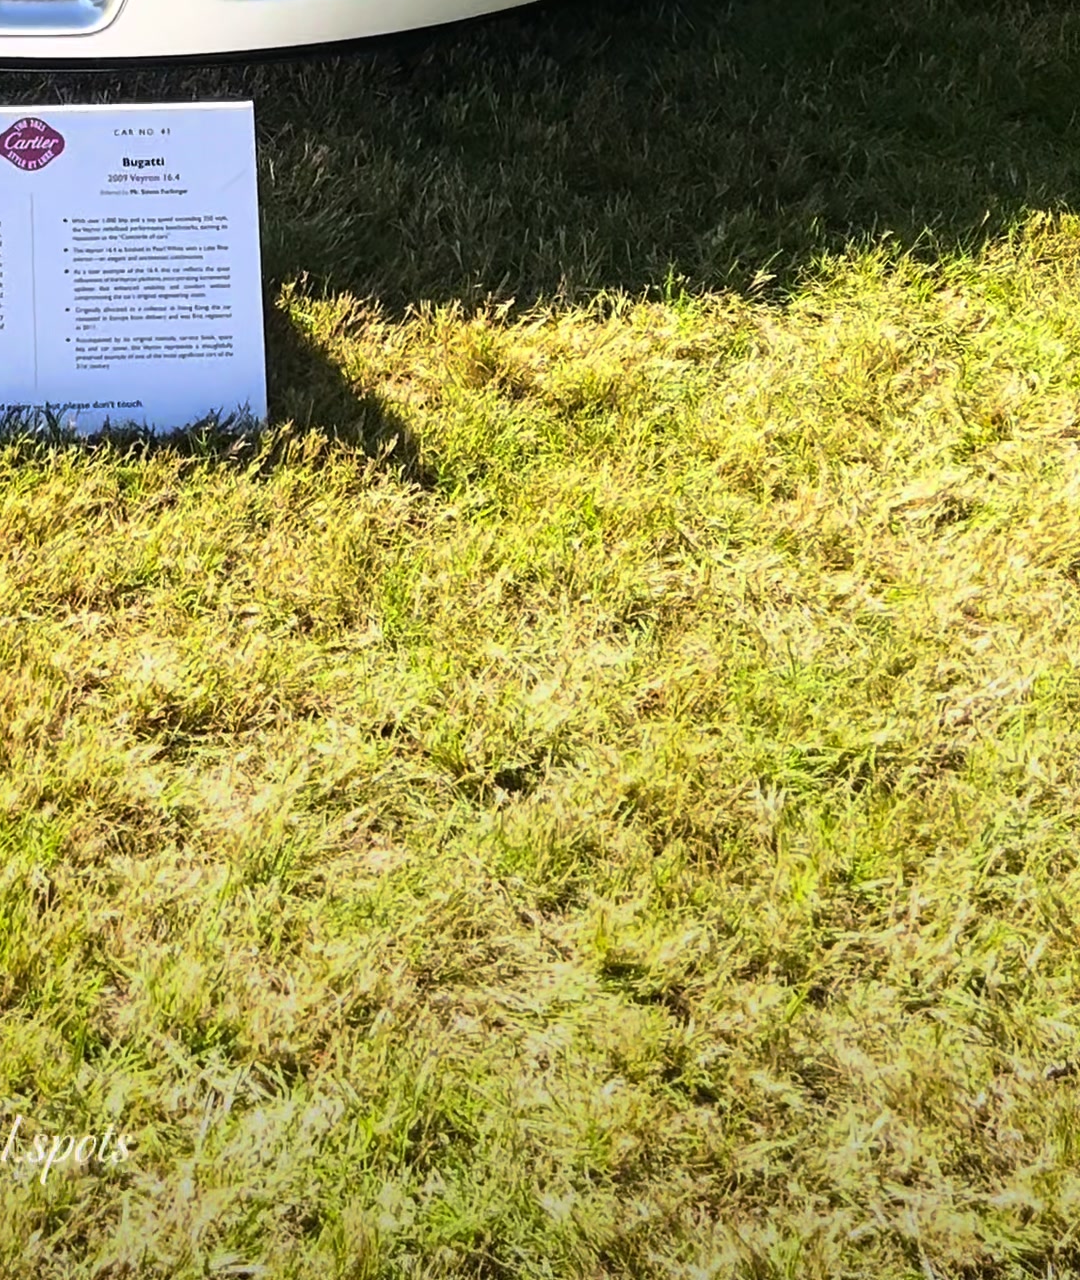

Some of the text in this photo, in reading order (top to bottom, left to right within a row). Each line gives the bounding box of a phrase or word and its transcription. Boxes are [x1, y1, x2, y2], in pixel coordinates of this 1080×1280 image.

[114, 128, 134, 136] CAR
[4, 131, 59, 150] Cartier
[122, 157, 165, 169] Bugatti
[130, 173, 160, 184] Veyron
[163, 173, 180, 181] 16.4
